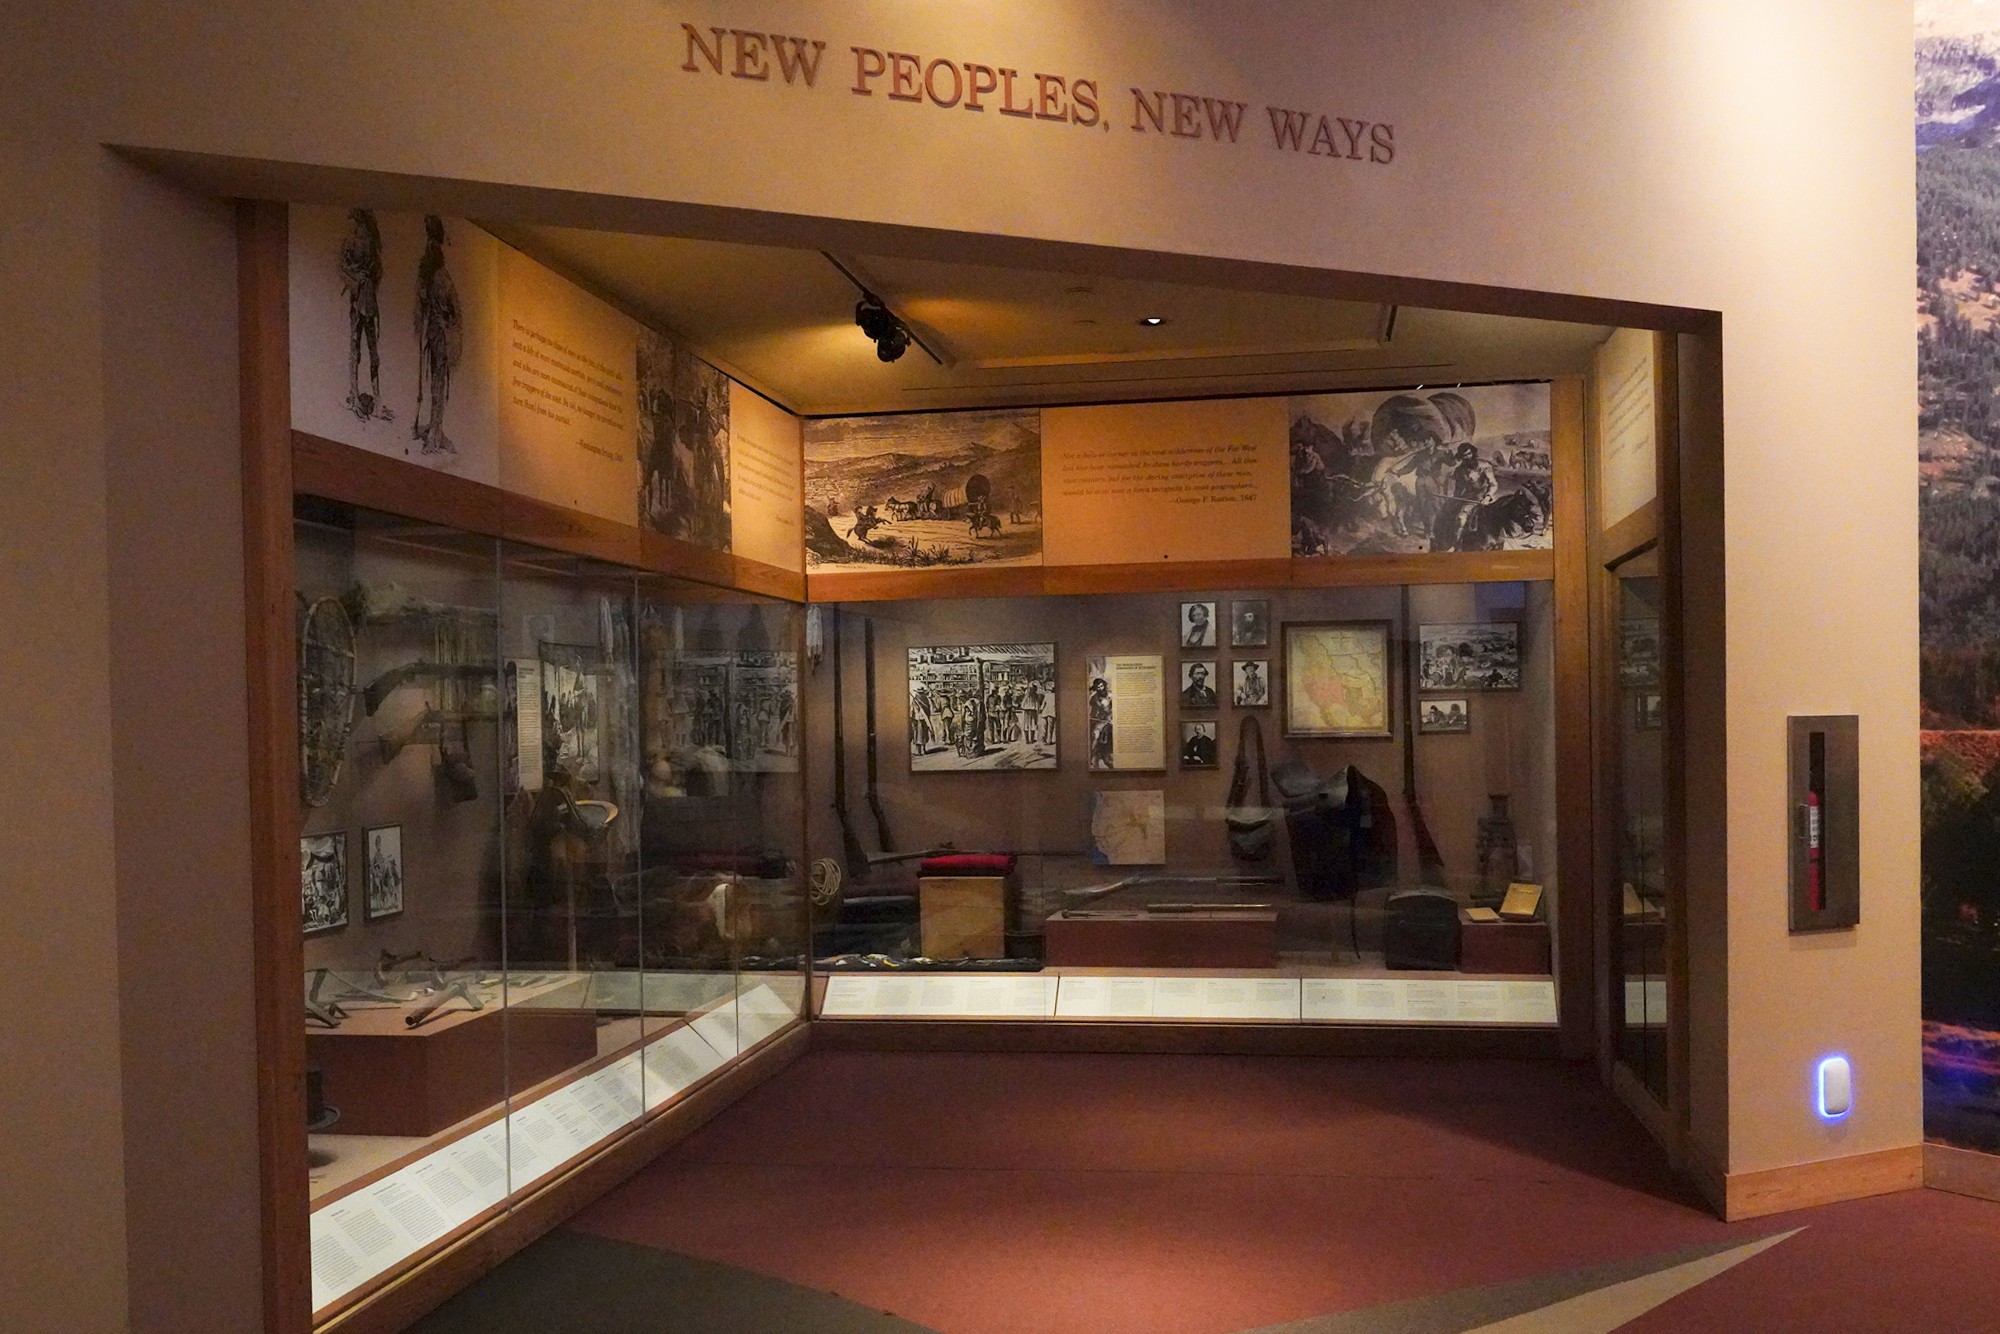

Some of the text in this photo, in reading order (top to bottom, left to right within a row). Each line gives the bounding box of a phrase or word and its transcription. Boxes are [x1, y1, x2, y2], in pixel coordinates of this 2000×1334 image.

[680, 22, 1396, 165] NEW PEOPLES, NEW WAYS
